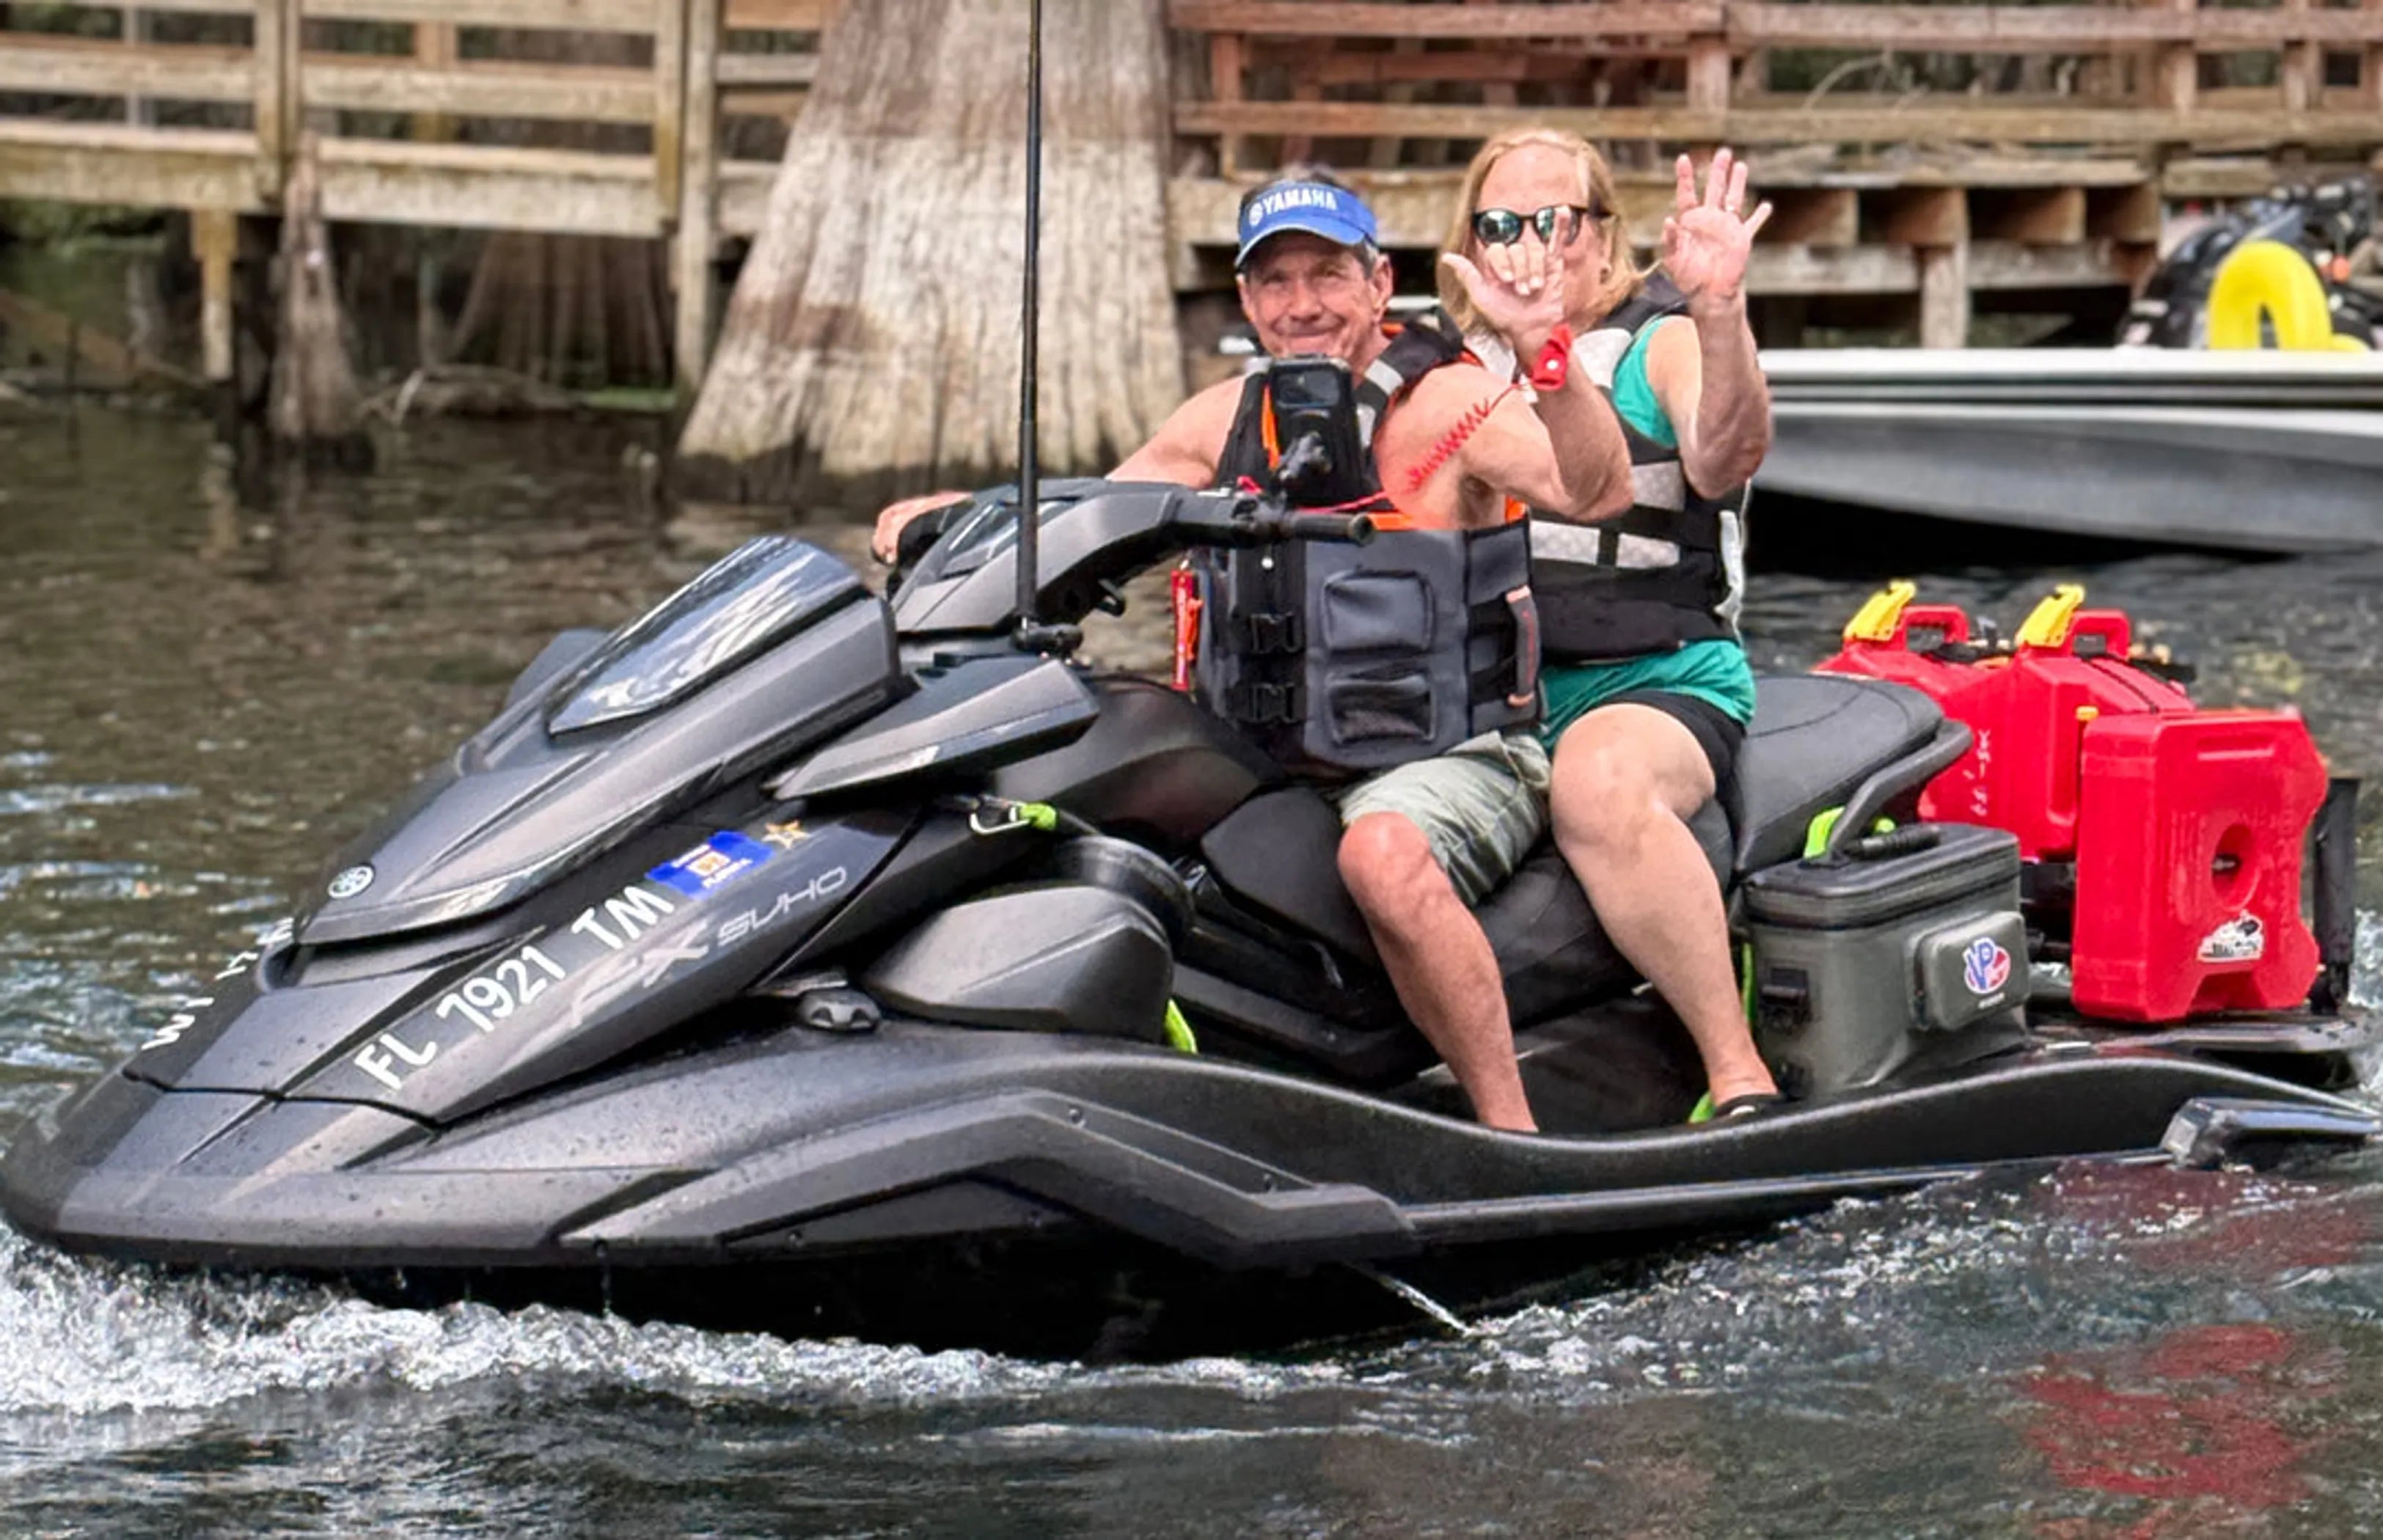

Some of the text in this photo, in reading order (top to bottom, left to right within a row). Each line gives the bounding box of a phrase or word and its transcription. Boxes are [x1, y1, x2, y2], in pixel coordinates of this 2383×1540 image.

[1262, 188, 1338, 216] YAMAHA
[717, 865, 846, 947] SVHO
[354, 1033, 438, 1090] FL
[571, 886, 675, 950] TM
